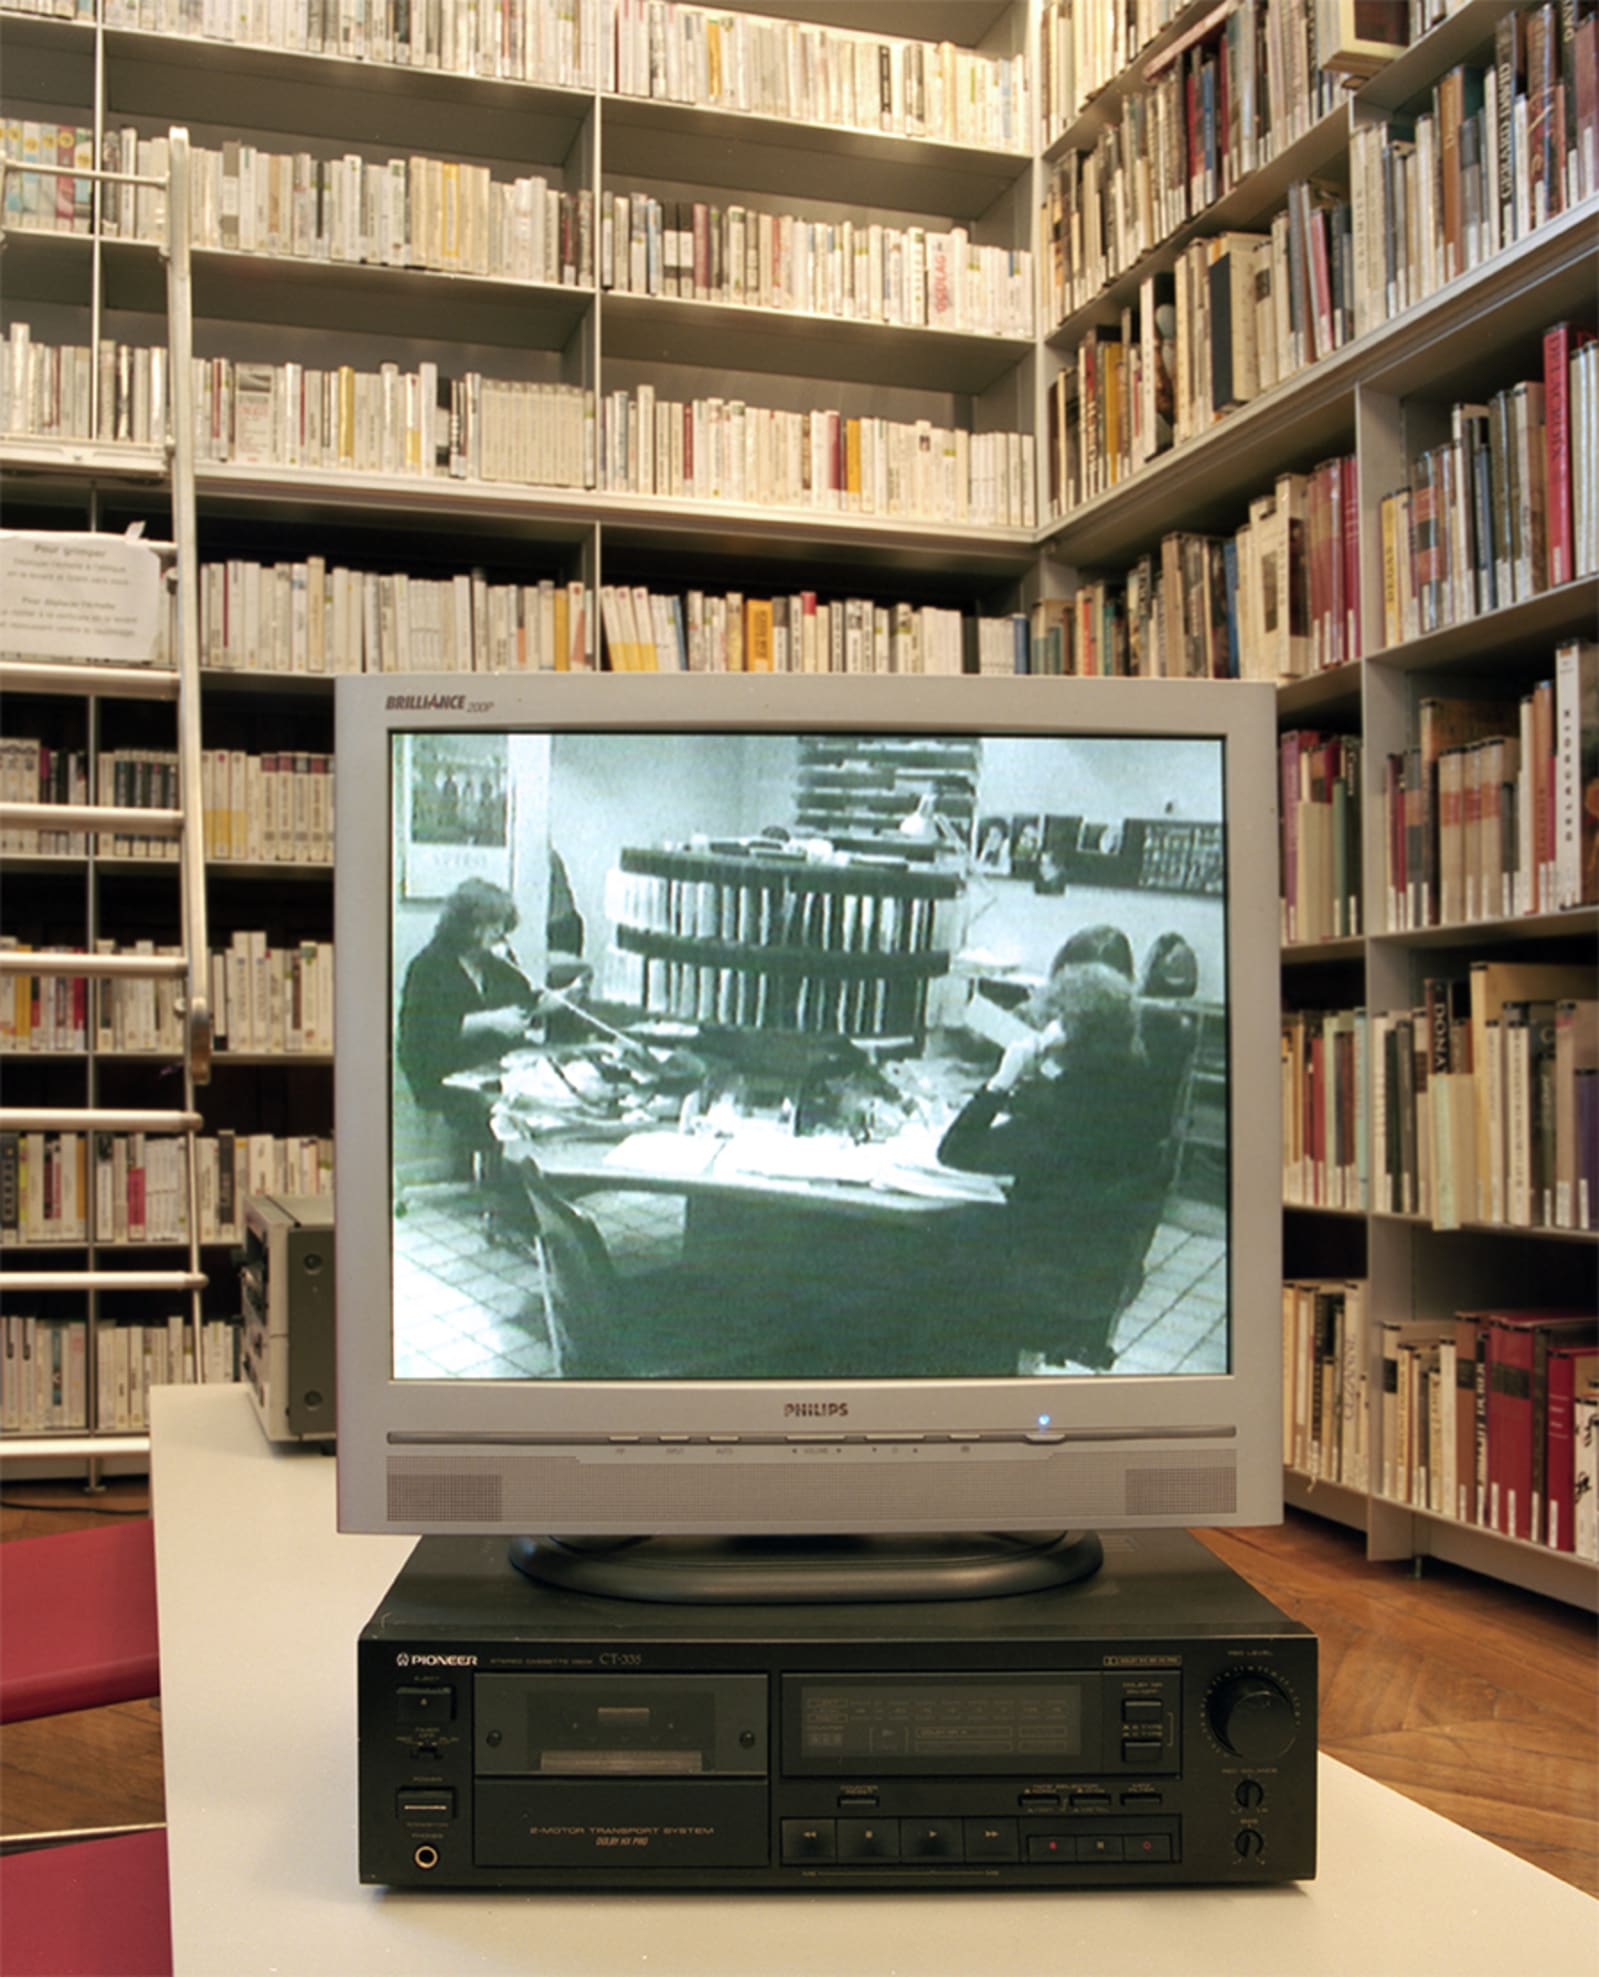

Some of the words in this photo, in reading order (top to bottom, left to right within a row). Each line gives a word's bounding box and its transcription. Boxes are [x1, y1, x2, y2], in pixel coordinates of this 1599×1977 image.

[1549, 333, 1563, 462] DELACROIX
[385, 694, 466, 710] BRILLIANCE
[784, 1402, 849, 1417] PHILIPS
[411, 1654, 478, 1666] PIONEER
[589, 1827, 660, 1835] TRANSPORT
[663, 1827, 715, 1835] SYSTEM
